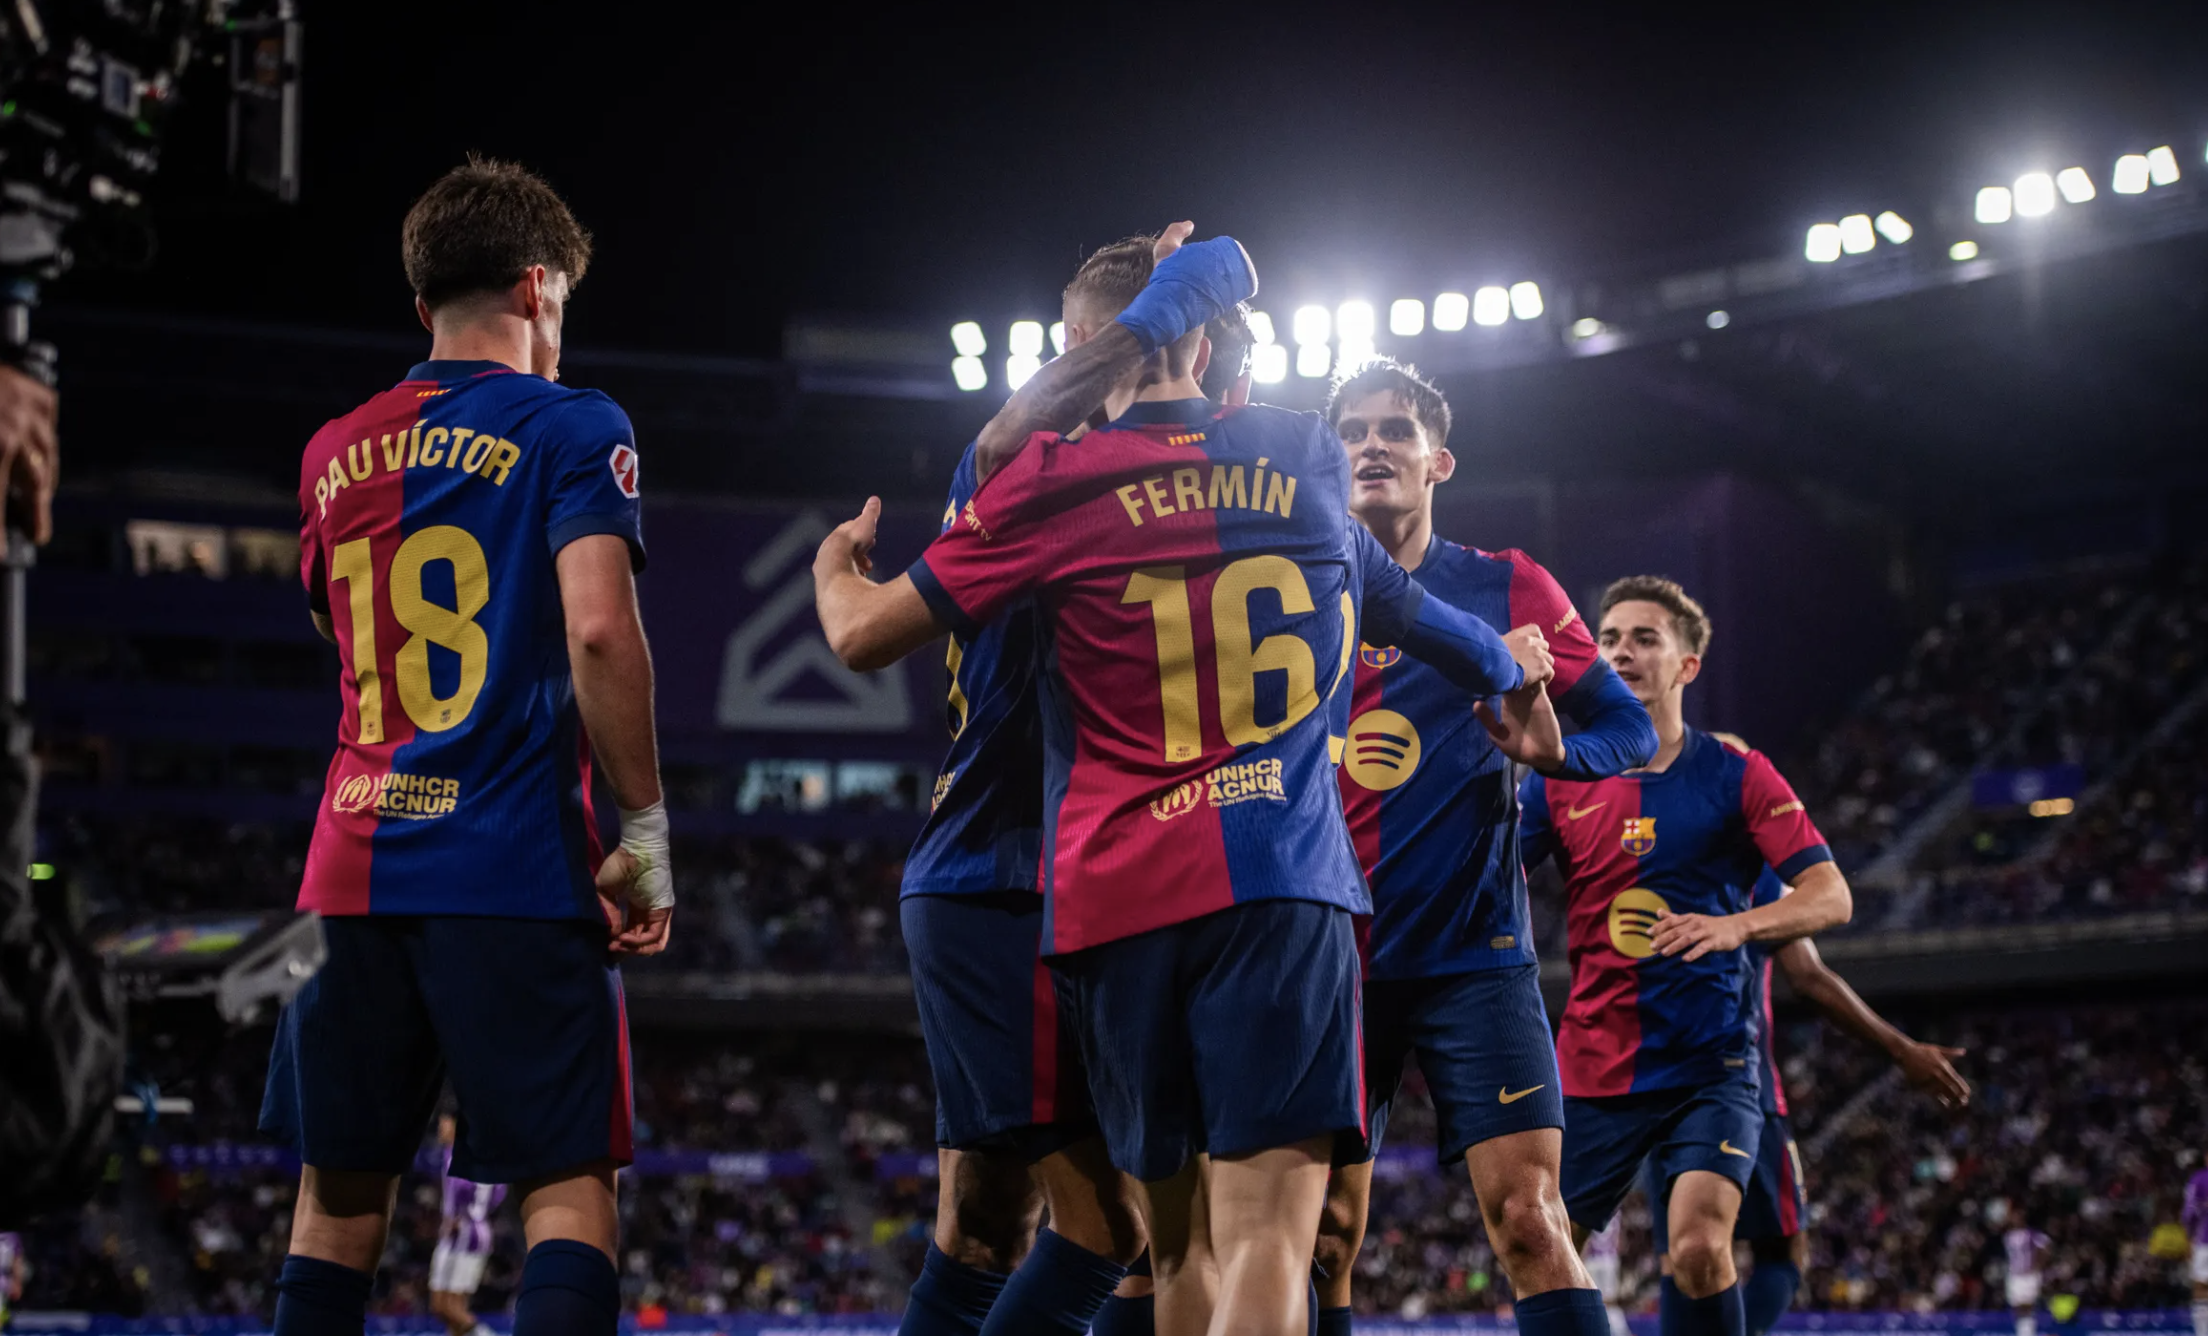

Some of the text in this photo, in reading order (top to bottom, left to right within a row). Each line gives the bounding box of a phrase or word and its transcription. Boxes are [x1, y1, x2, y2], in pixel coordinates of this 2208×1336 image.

[315, 418, 521, 521] PAU VÍCTOR
[1115, 456, 1297, 527] FERMÍN
[331, 525, 490, 745] 18
[1120, 555, 1320, 763] 16
[380, 773, 460, 797] UNHCR
[1205, 758, 1283, 785] UNHCR
[1207, 775, 1285, 800] ACNUR
[373, 791, 457, 814] ACNUR
